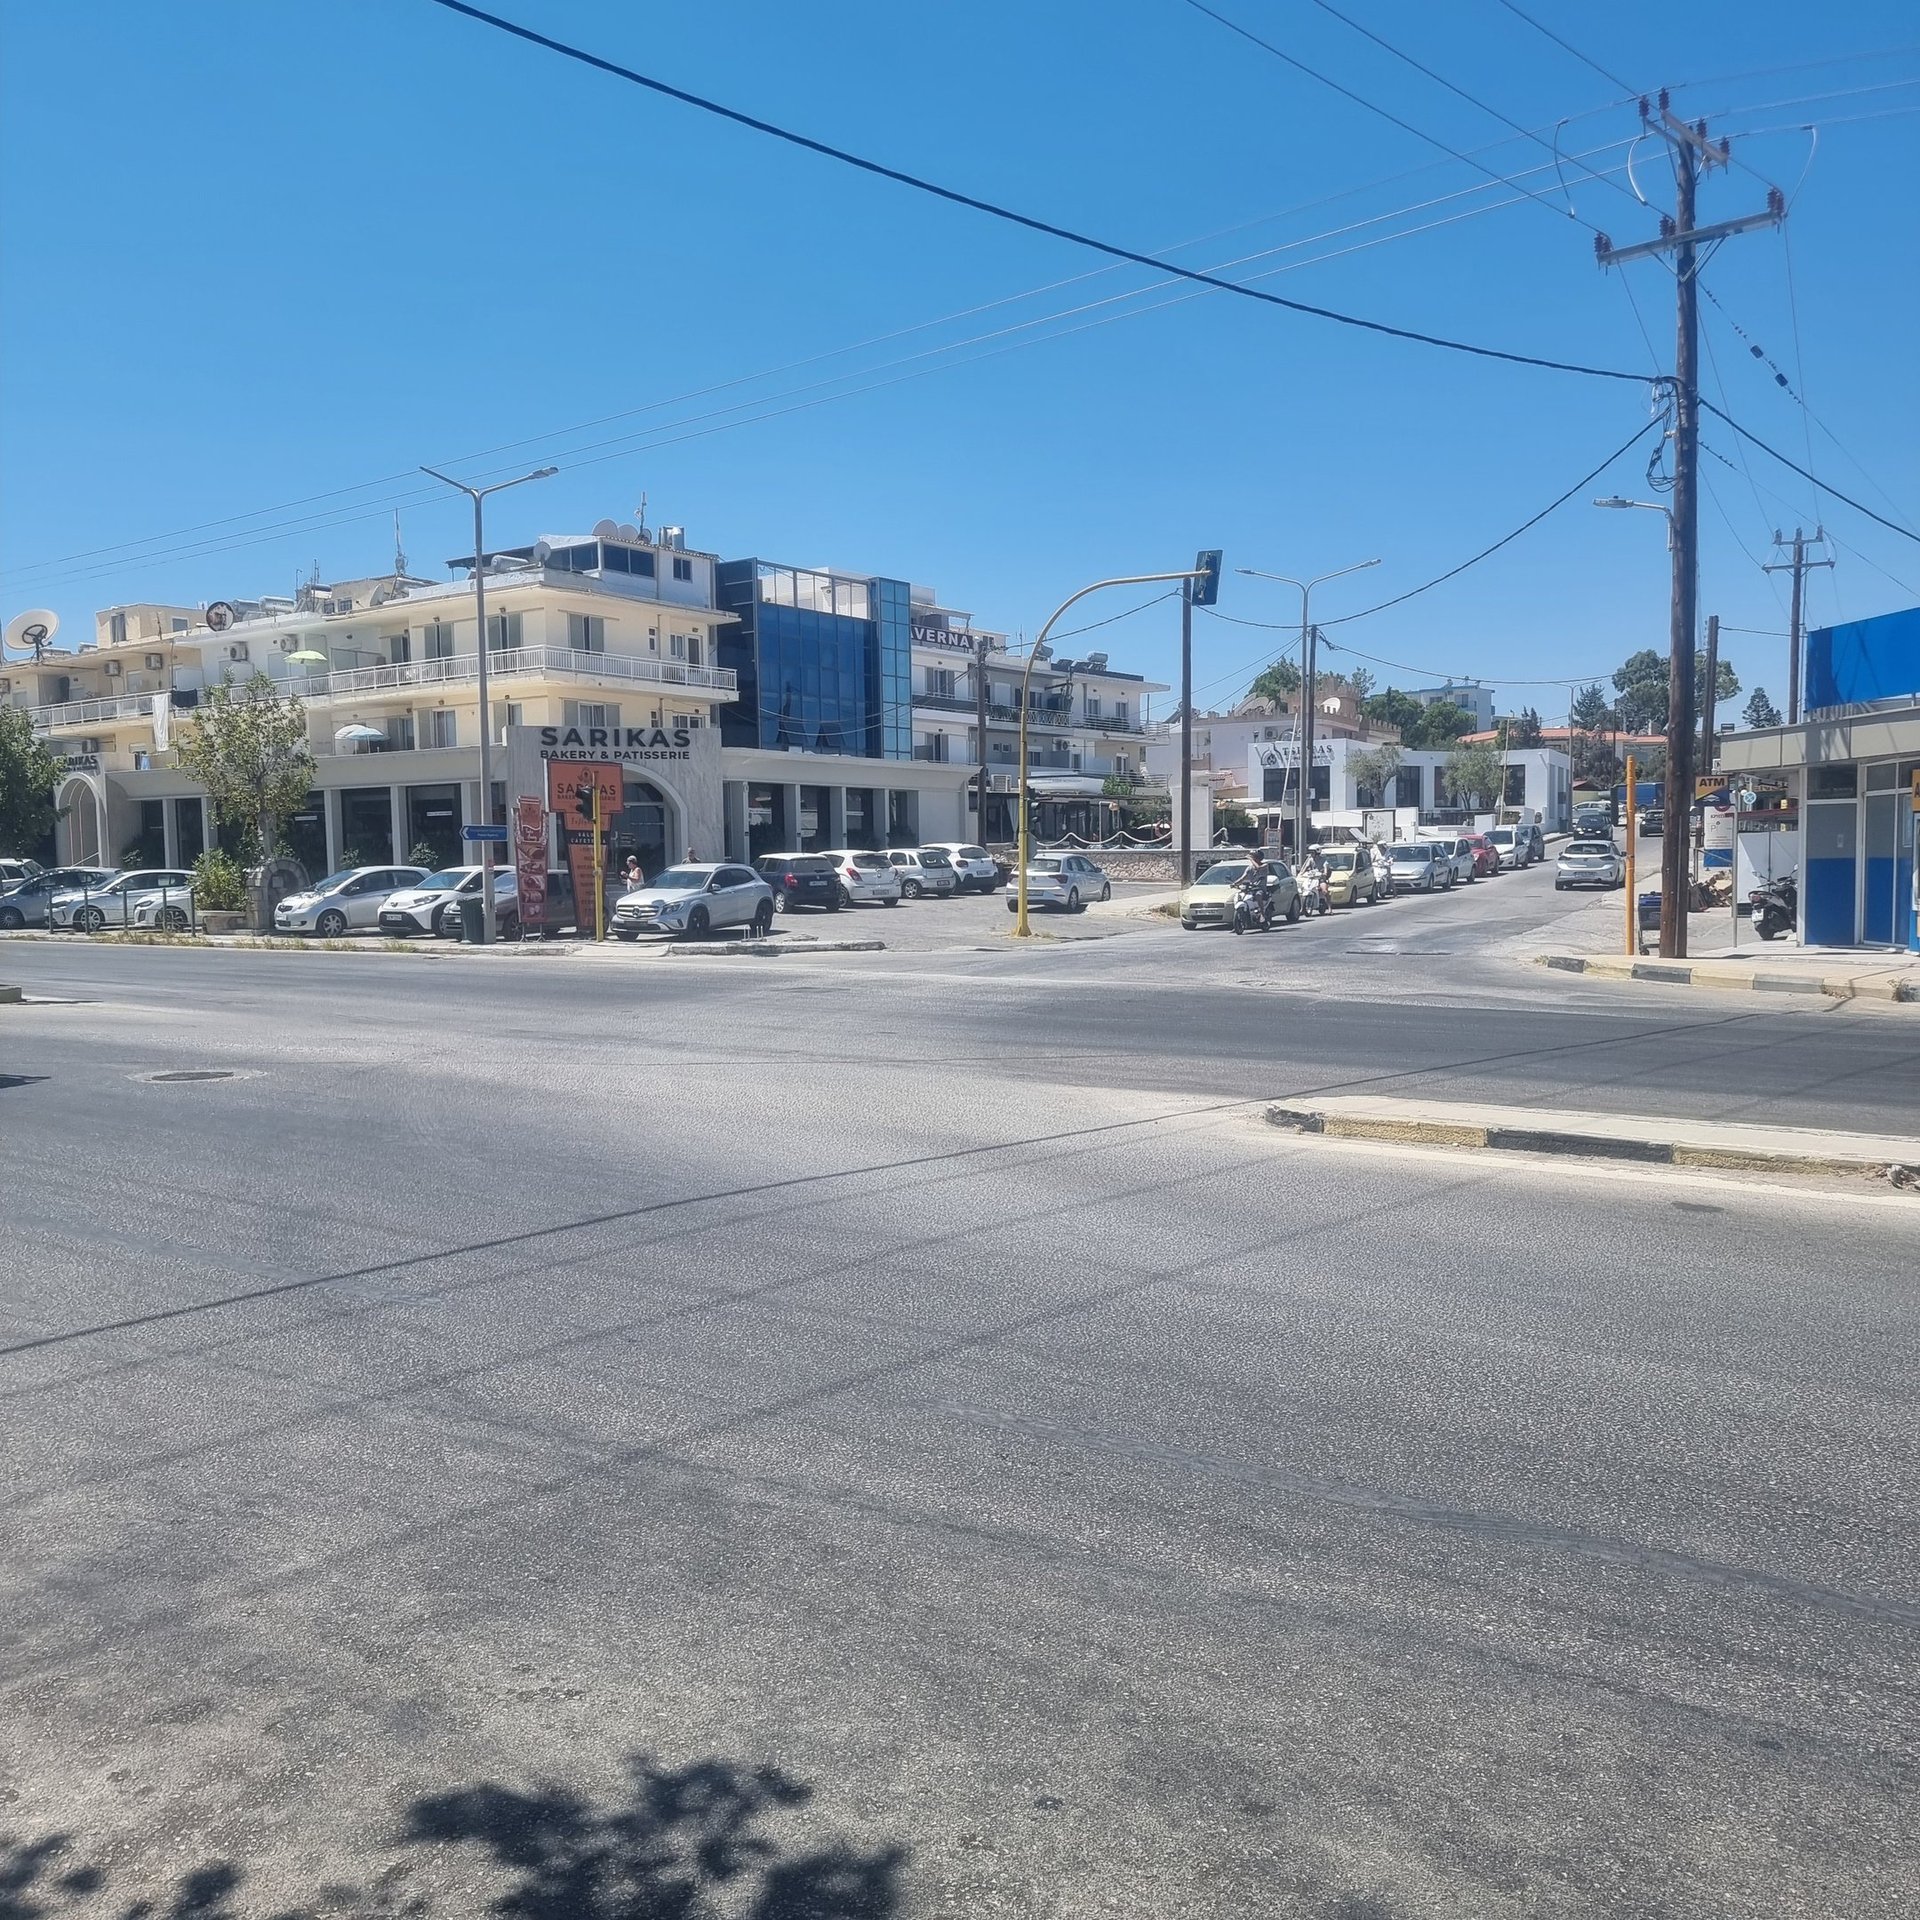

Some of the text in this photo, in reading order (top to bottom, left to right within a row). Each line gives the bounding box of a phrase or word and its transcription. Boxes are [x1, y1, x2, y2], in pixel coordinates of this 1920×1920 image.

[541, 727, 690, 747] SARIKAS
[540, 750, 690, 760] BAKERY & PATISSERIE
[1699, 778, 1725, 787] ATM
